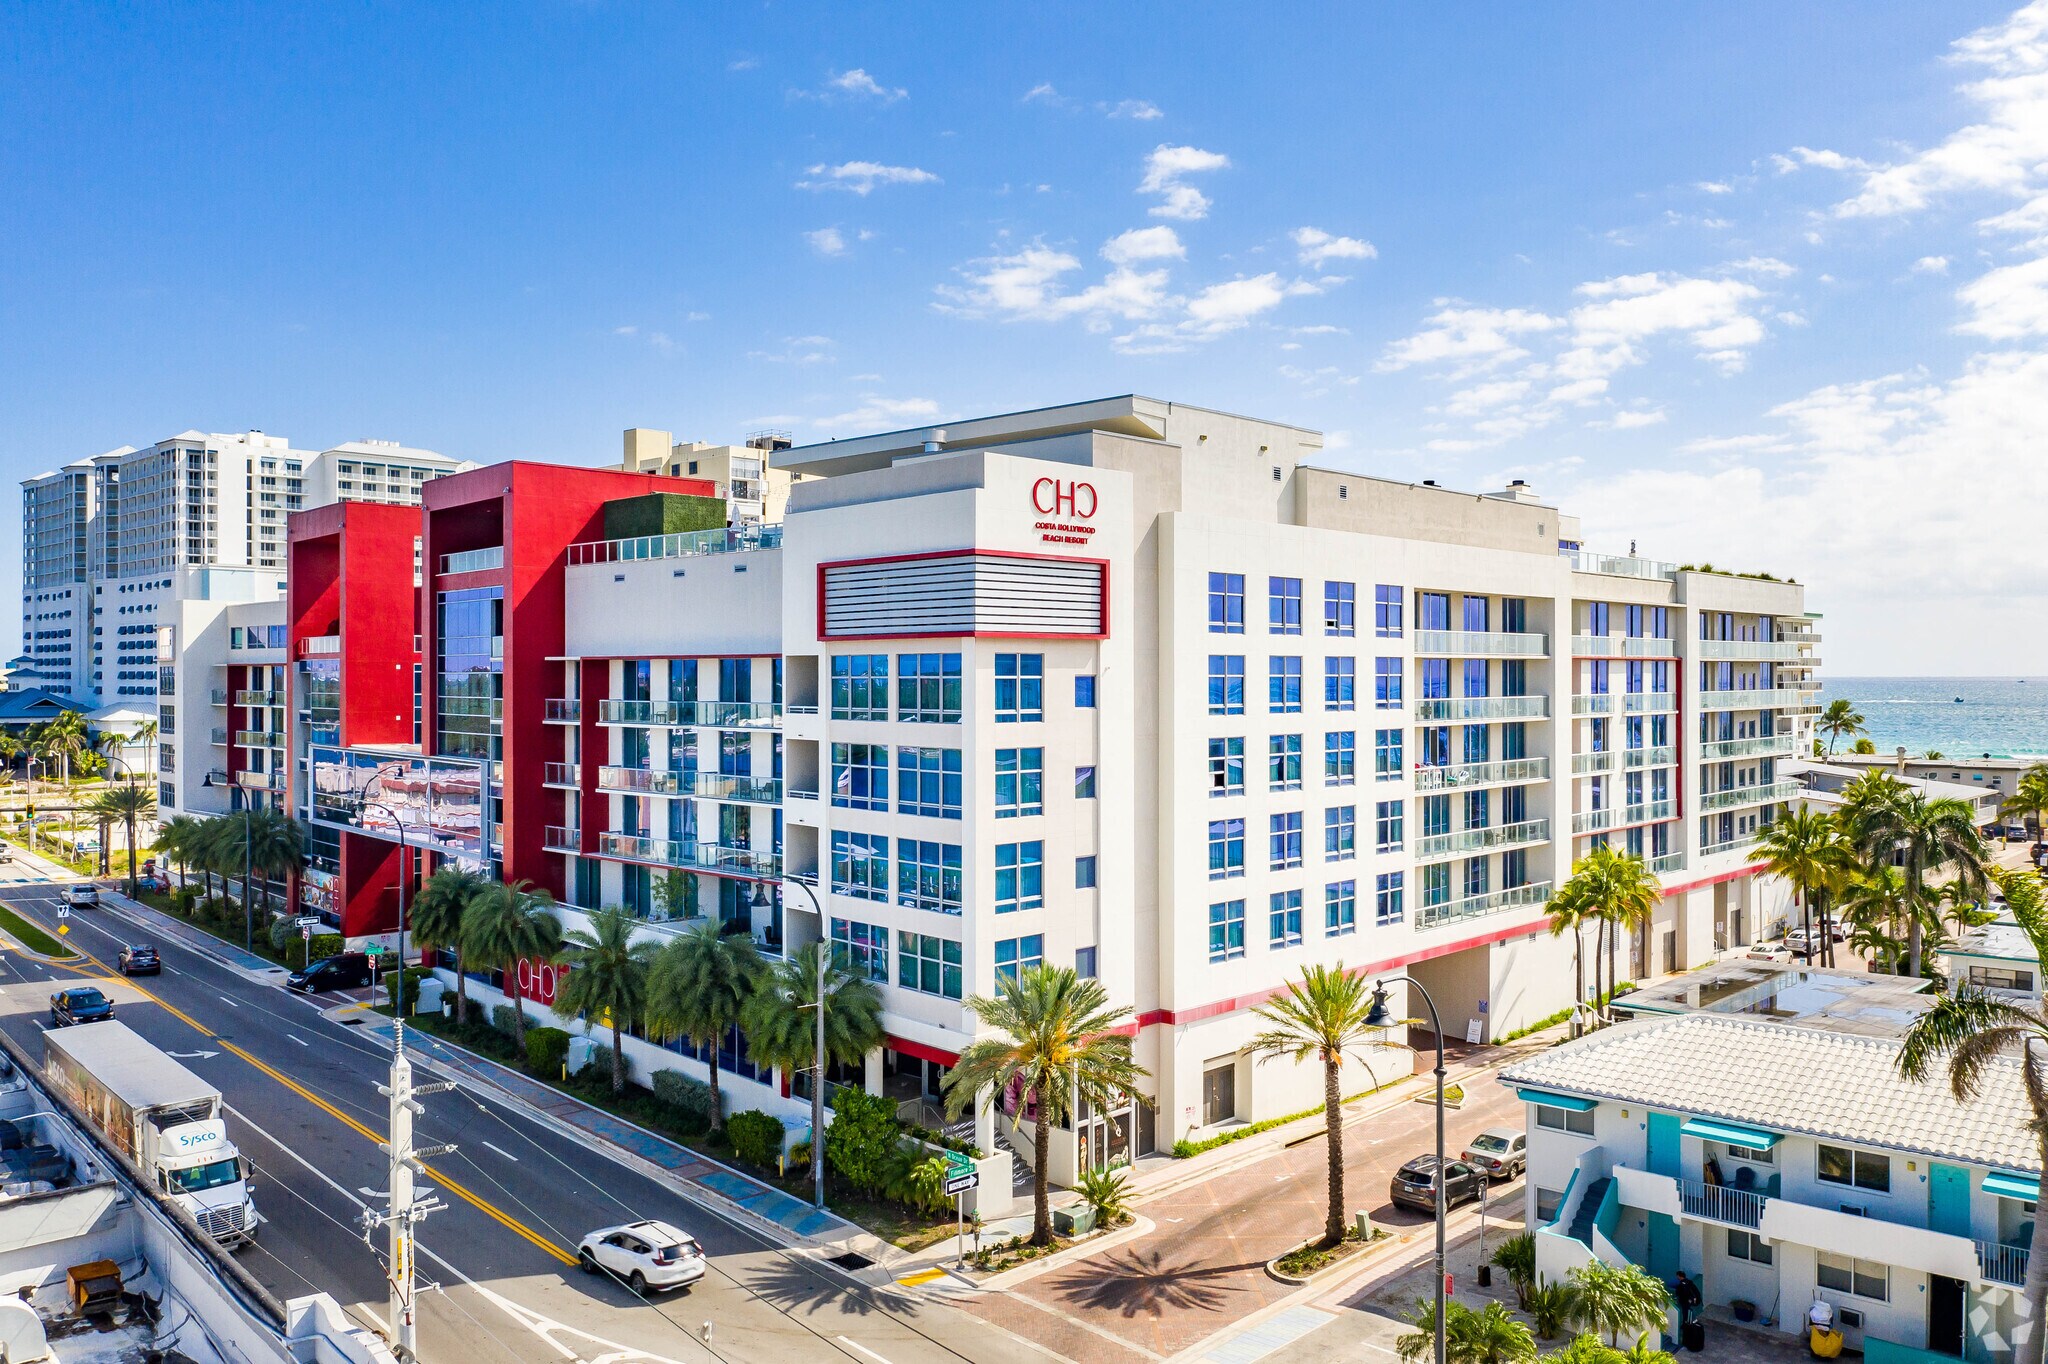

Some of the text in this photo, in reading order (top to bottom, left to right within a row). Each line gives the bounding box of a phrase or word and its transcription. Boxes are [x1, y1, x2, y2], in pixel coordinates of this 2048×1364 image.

[1035, 521, 1096, 535] COSTA HOLLYWOOD
[1042, 533, 1088, 545] BEACH RESORT
[180, 1132, 217, 1147] Sysco
